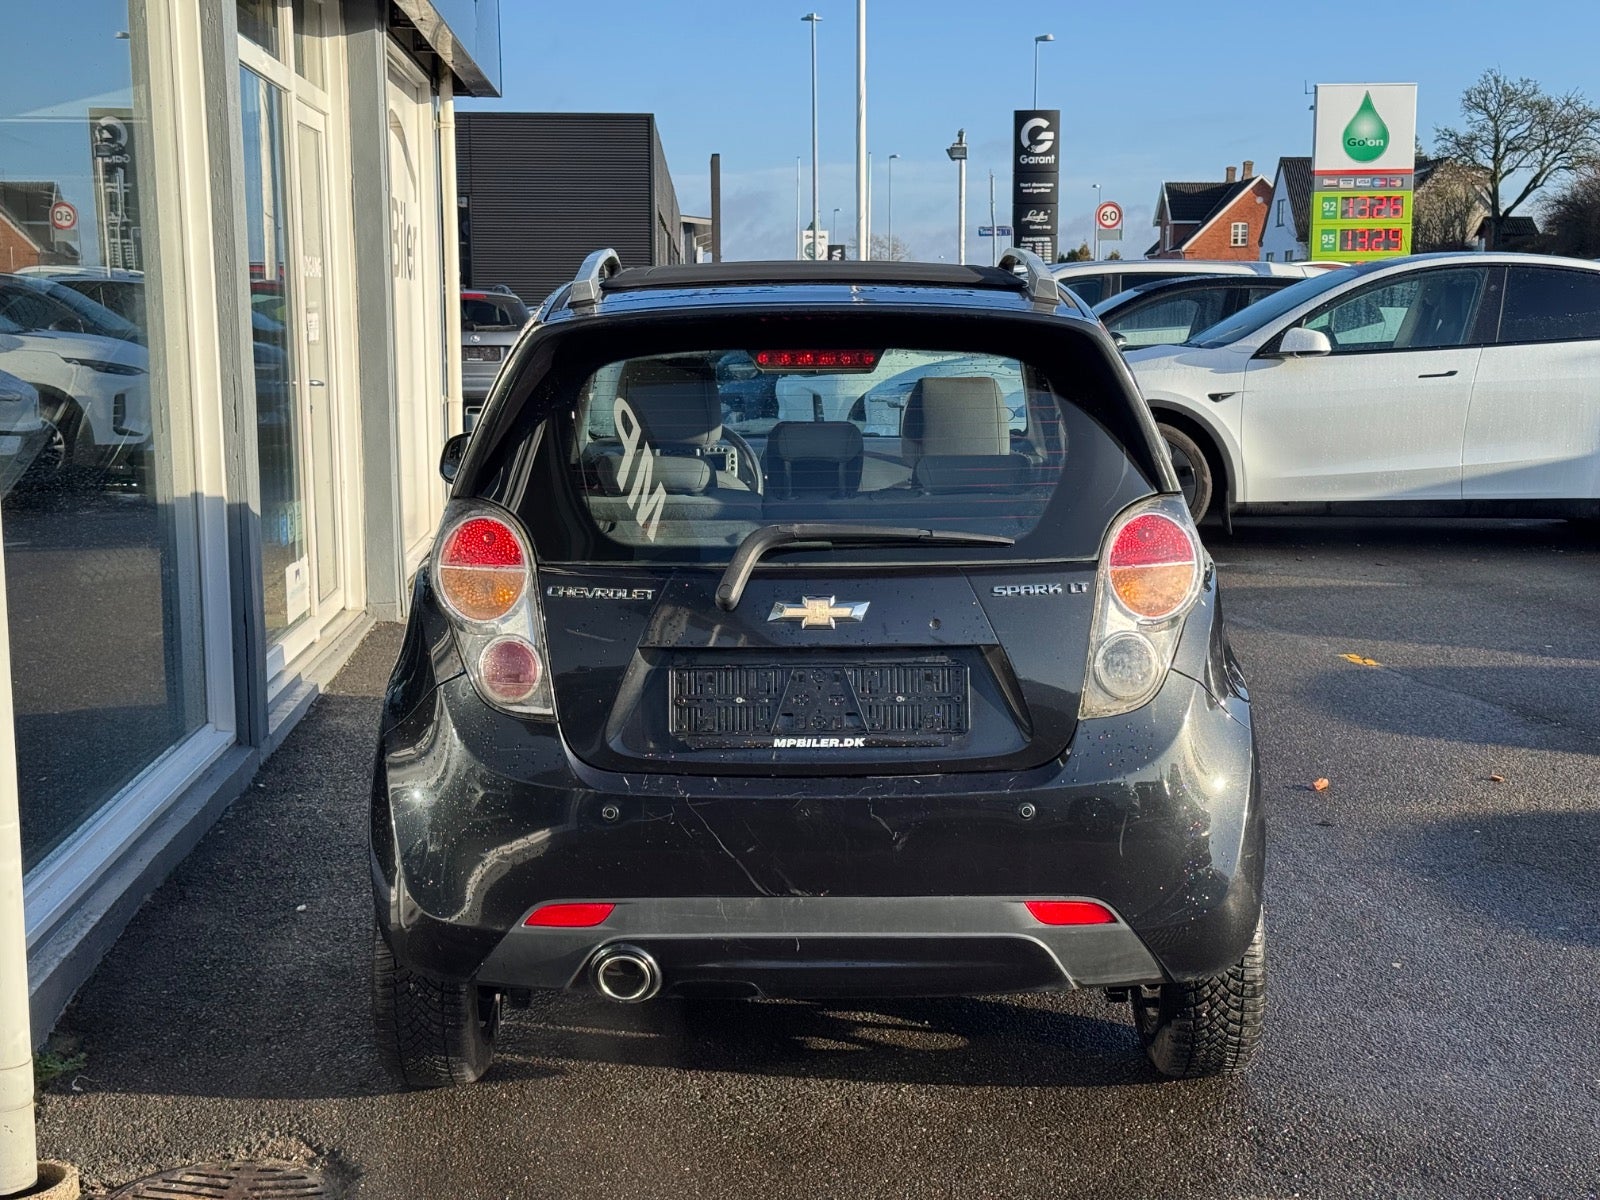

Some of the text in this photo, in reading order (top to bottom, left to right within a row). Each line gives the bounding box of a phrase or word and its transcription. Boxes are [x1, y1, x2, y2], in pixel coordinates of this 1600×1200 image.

[1019, 154, 1056, 165] Garant
[1322, 201, 1336, 211] 92
[1101, 210, 1117, 222] 60
[391, 197, 417, 281] Biler
[1321, 234, 1335, 244] 95
[547, 585, 656, 600] CHEVROLET
[992, 581, 1089, 597] SPARK LT
[773, 736, 866, 749] MPBILER.DK
